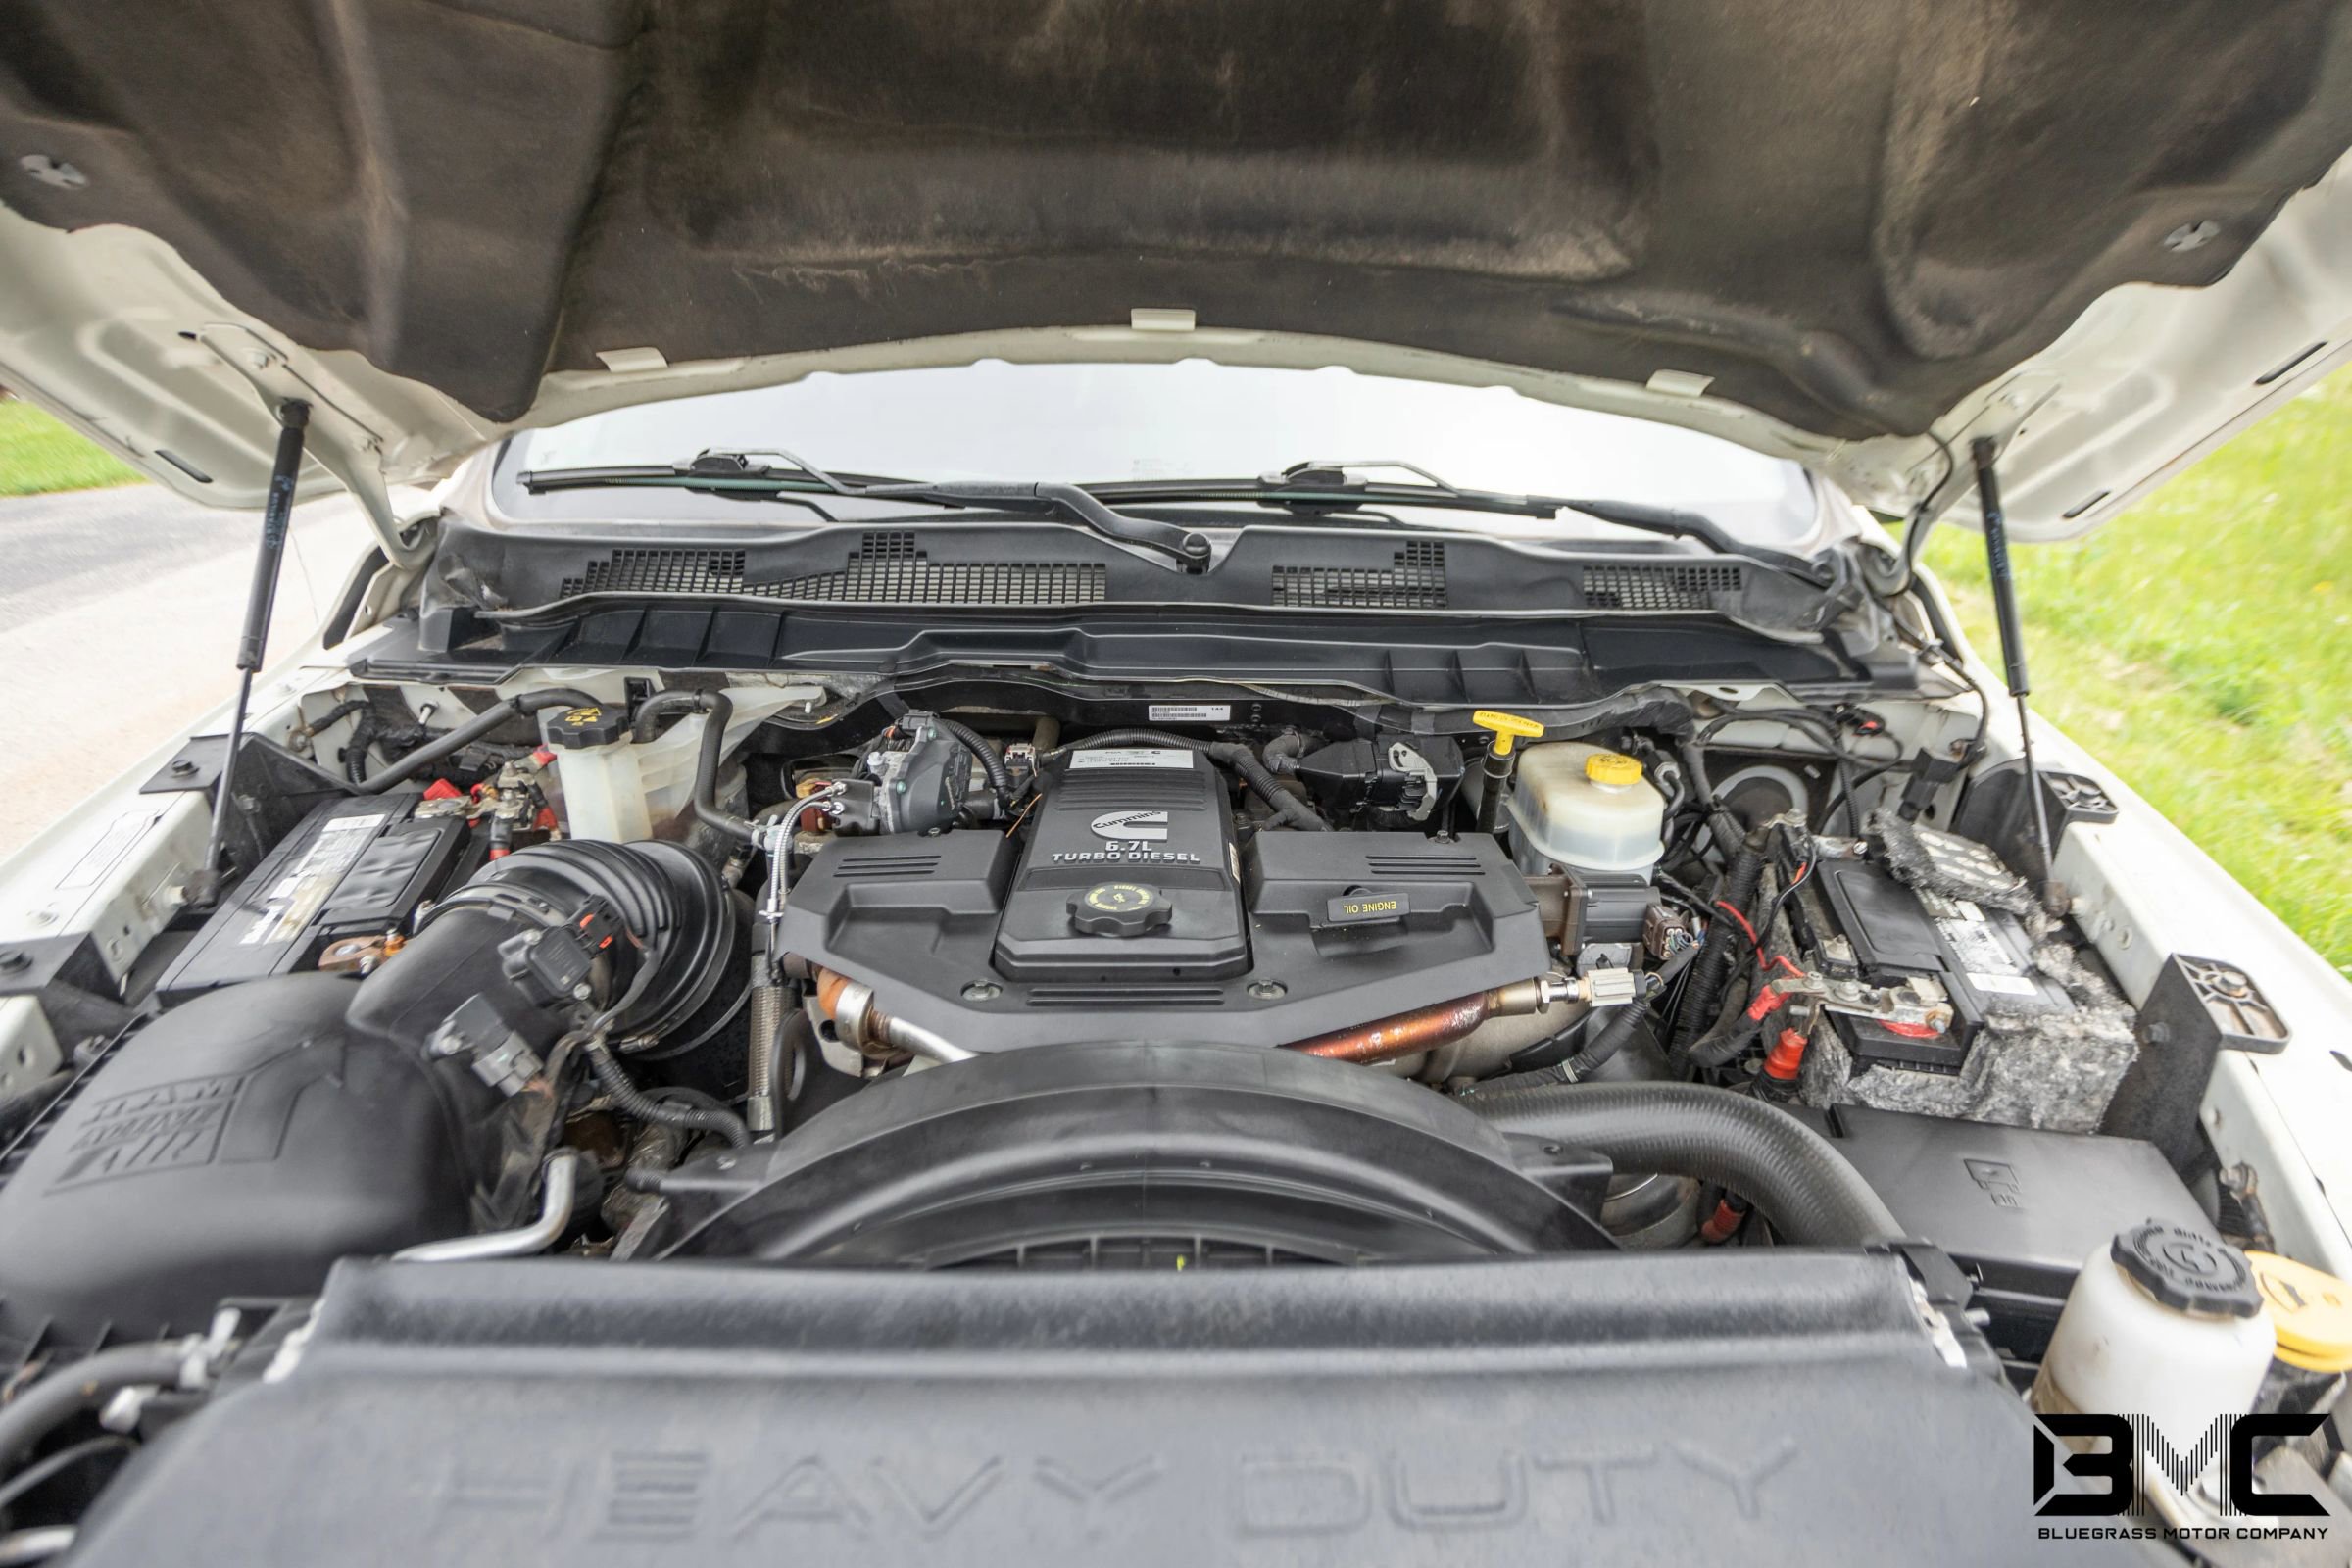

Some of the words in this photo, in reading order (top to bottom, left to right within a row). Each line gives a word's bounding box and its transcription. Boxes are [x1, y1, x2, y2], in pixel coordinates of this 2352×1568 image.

[1092, 810, 1161, 828] Cummins
[1105, 840, 1152, 853] 6.7L
[1052, 852, 1121, 862] TURBO
[1128, 852, 1200, 863] DIESEL
[1343, 904, 1360, 914] OIL
[1362, 901, 1397, 913] ENGINE
[421, 1449, 1166, 1546] HEAVY
[1237, 1438, 1800, 1539] DUTY
